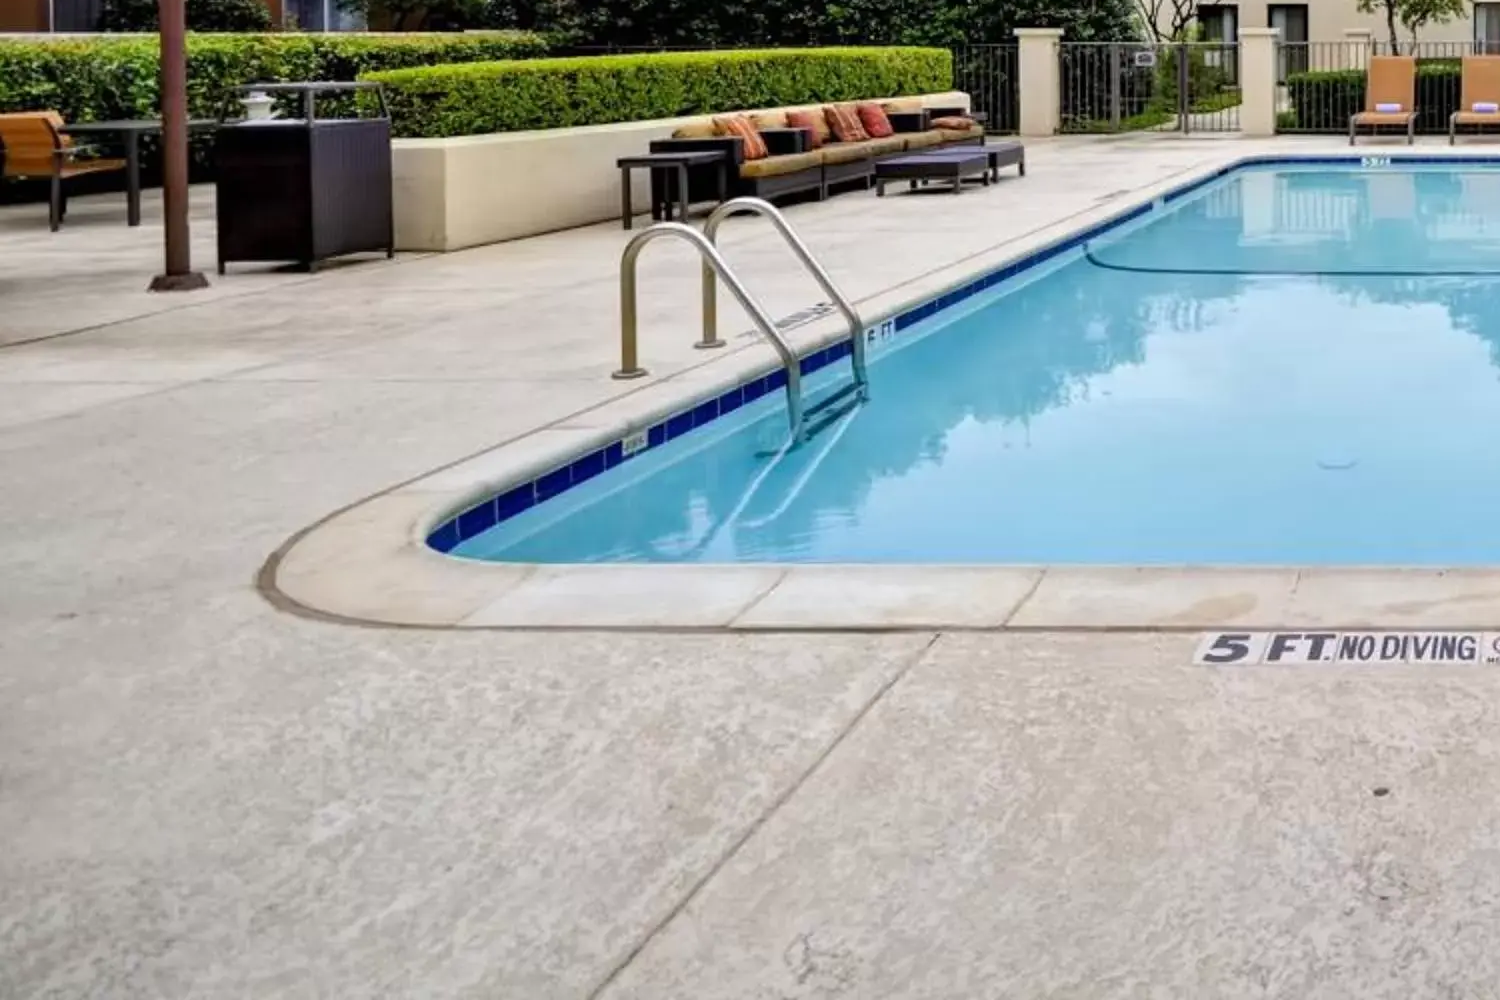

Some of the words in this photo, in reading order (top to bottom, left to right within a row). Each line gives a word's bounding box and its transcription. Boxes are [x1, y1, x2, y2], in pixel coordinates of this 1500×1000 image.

[1203, 634, 1250, 662] 5
[1339, 635, 1375, 661] NO
[1380, 635, 1476, 661] DIVING
